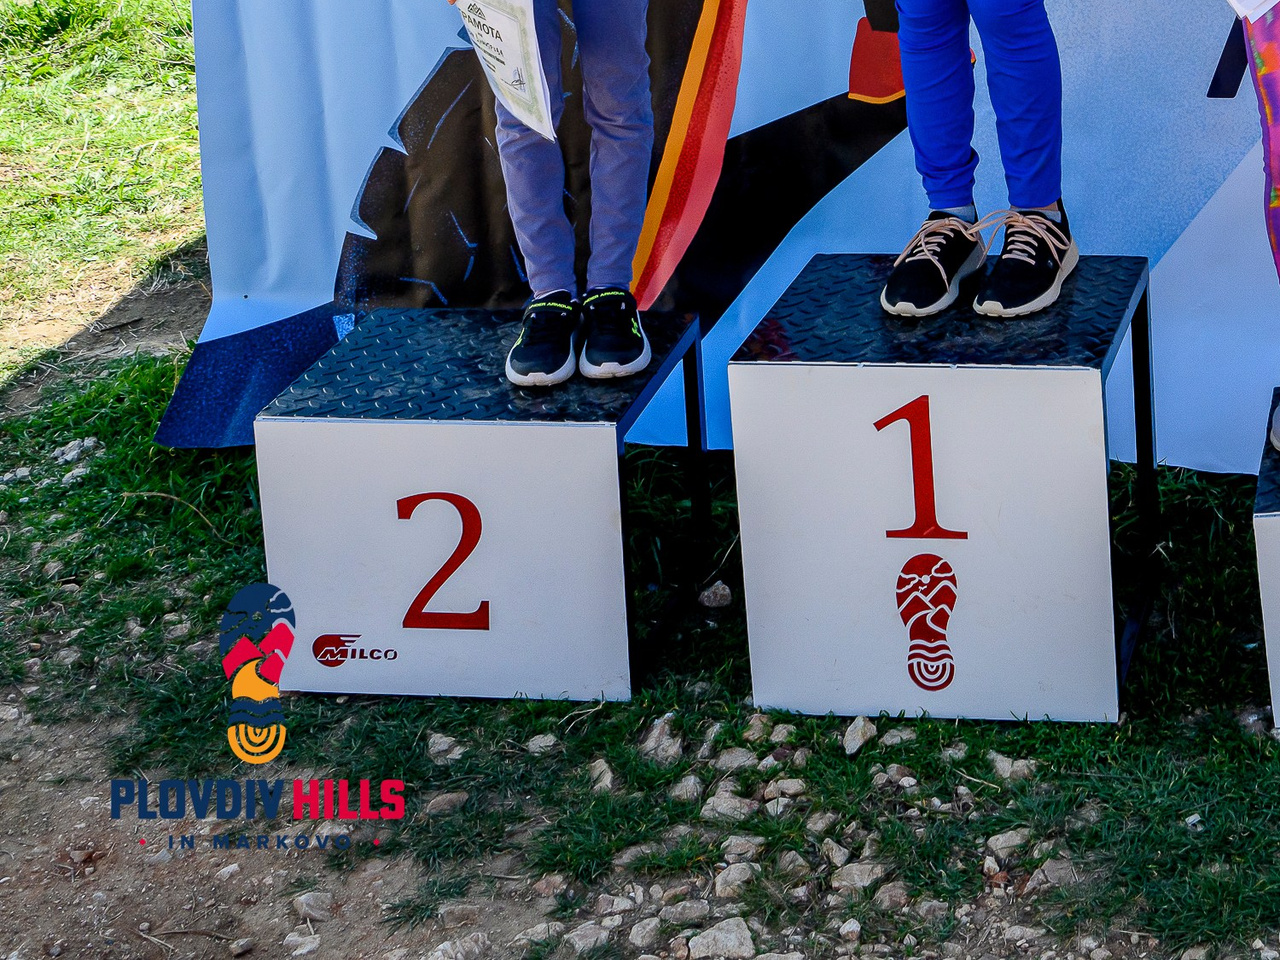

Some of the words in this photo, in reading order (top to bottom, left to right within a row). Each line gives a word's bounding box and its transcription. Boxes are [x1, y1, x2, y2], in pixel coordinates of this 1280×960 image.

[458, 7, 504, 43] РАМОТА
[872, 394, 969, 540] 1
[396, 491, 490, 631] 2
[316, 646, 398, 661] MILCO
